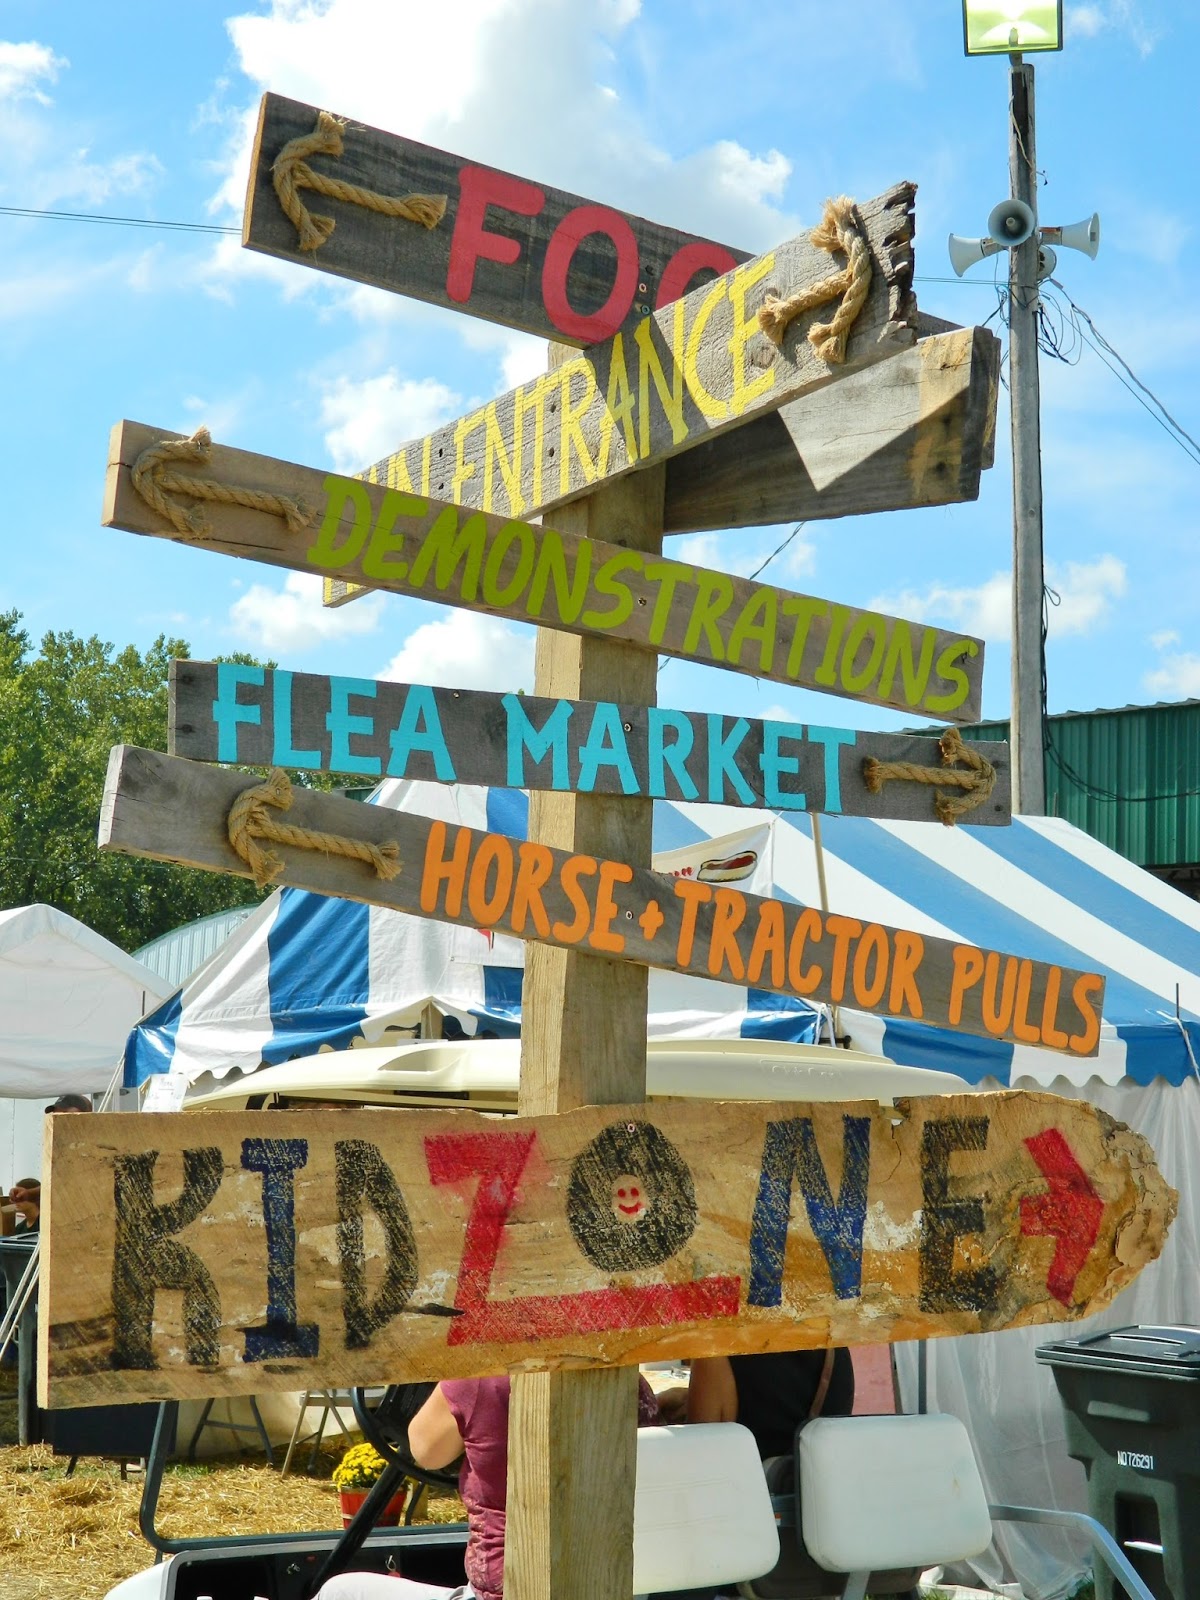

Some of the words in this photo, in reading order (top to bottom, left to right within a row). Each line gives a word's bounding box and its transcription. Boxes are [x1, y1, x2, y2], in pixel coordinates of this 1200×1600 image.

[451, 252, 776, 518] ENTRANCE
[306, 475, 979, 714] DEMONSTRATIONS
[212, 663, 457, 782] FLEA
[501, 693, 857, 813] MARKET
[421, 820, 633, 953] HORSE
[674, 878, 925, 1020] TRACTOR
[948, 945, 1107, 1055] PULLS
[110, 1136, 420, 1372] KID
[423, 1114, 1001, 1347] ZONE
